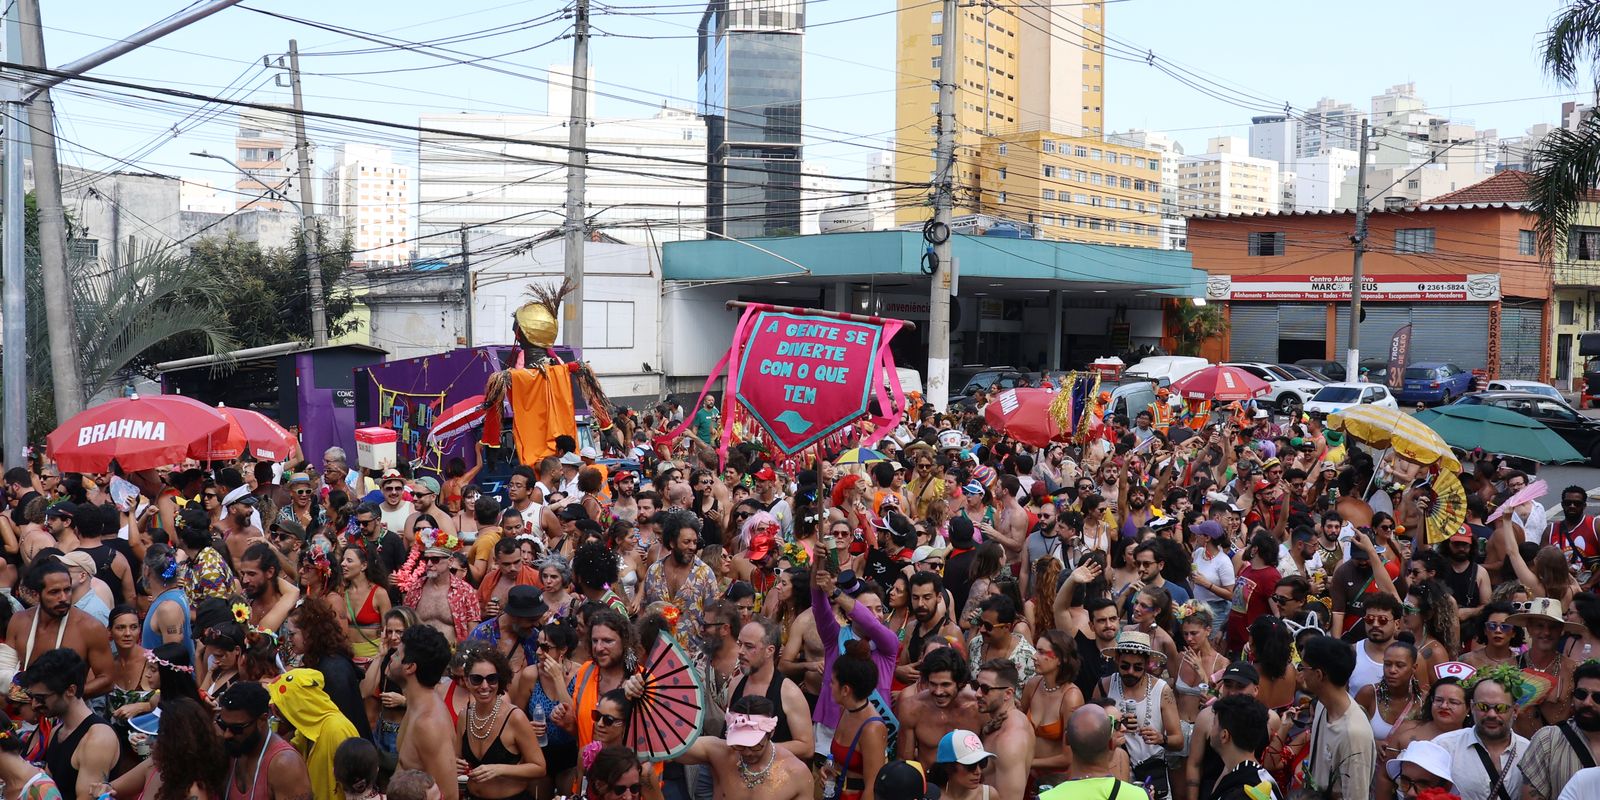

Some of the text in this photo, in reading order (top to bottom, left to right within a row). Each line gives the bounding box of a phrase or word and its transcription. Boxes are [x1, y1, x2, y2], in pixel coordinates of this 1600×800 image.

[1349, 283, 1378, 291] PEUS
[1360, 292, 1384, 300] uspensão
[1388, 292, 1421, 300] Escapamento
[766, 320, 869, 345] A GENTE SE
[1488, 310, 1497, 380] BORRACHARI
[776, 341, 847, 361] DIVERTE
[1391, 336, 1399, 361] TROCA
[760, 359, 849, 384] COM O QUE
[784, 384, 817, 405] TEM
[77, 418, 165, 447] BRAHMA
